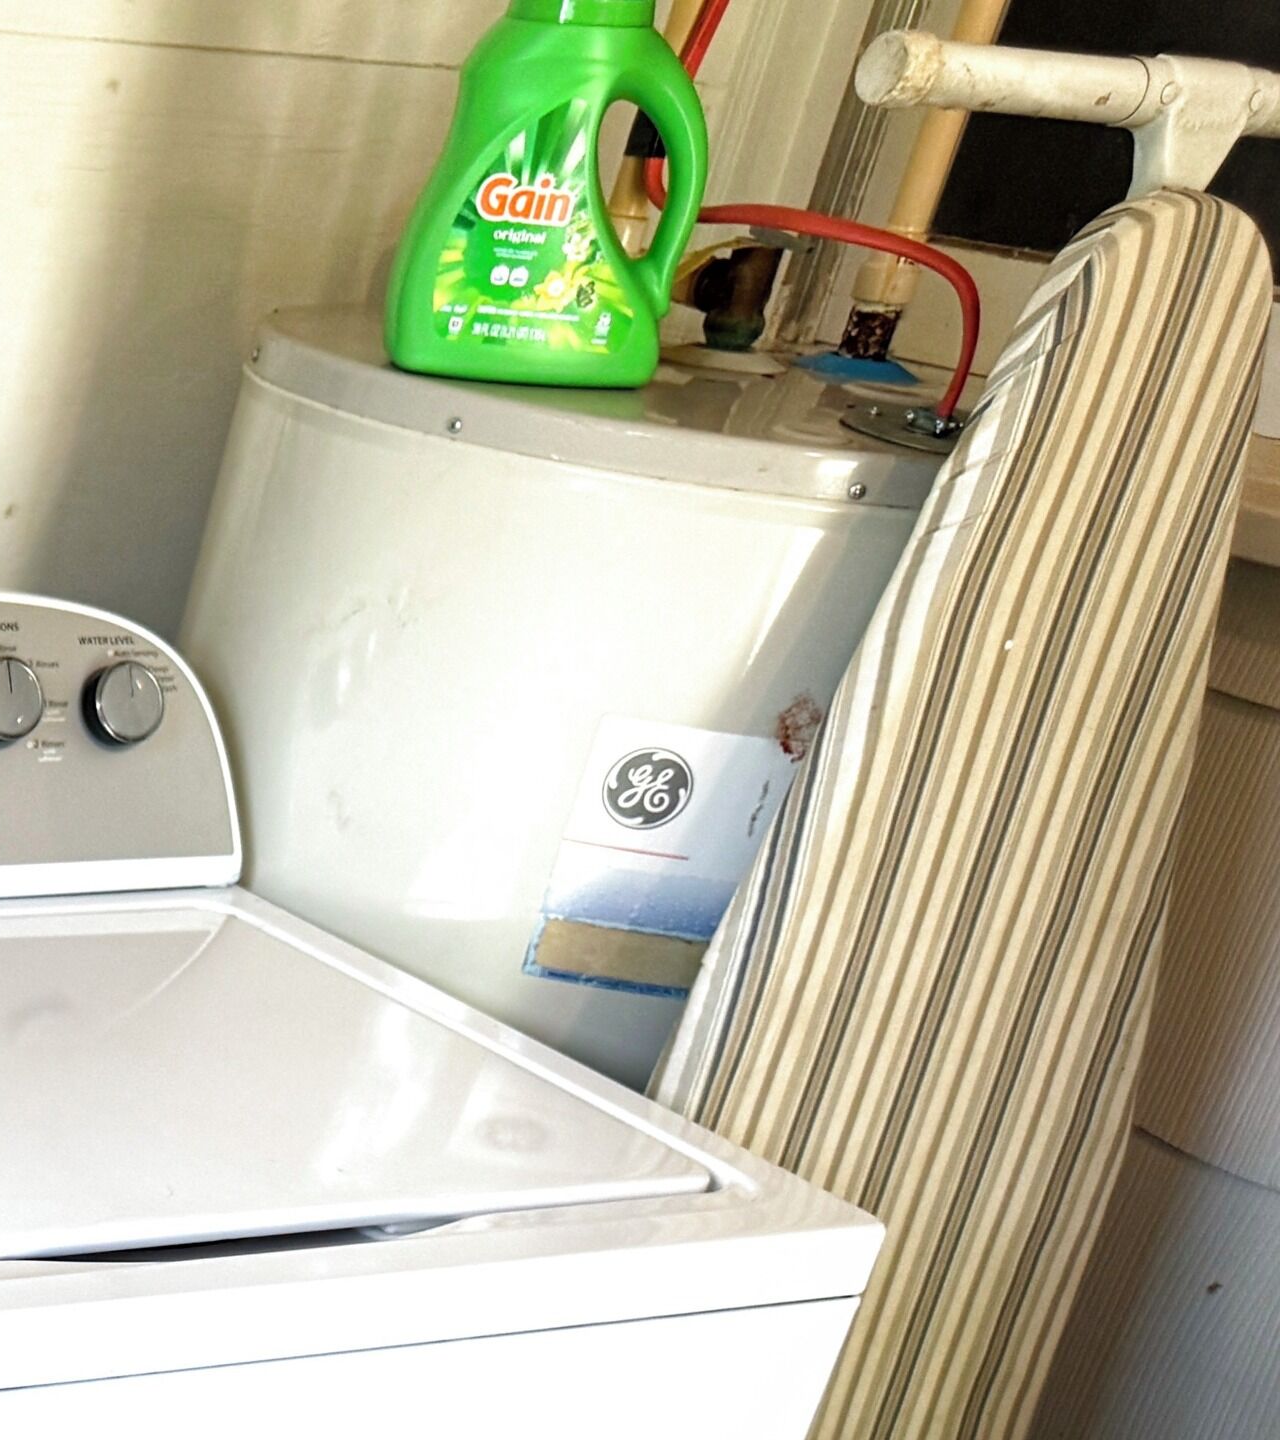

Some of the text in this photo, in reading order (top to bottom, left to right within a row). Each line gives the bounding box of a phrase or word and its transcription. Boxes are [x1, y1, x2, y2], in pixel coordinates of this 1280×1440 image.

[480, 177, 571, 222] Gain
[493, 227, 547, 244] original
[79, 637, 135, 646] WATER LEVEL
